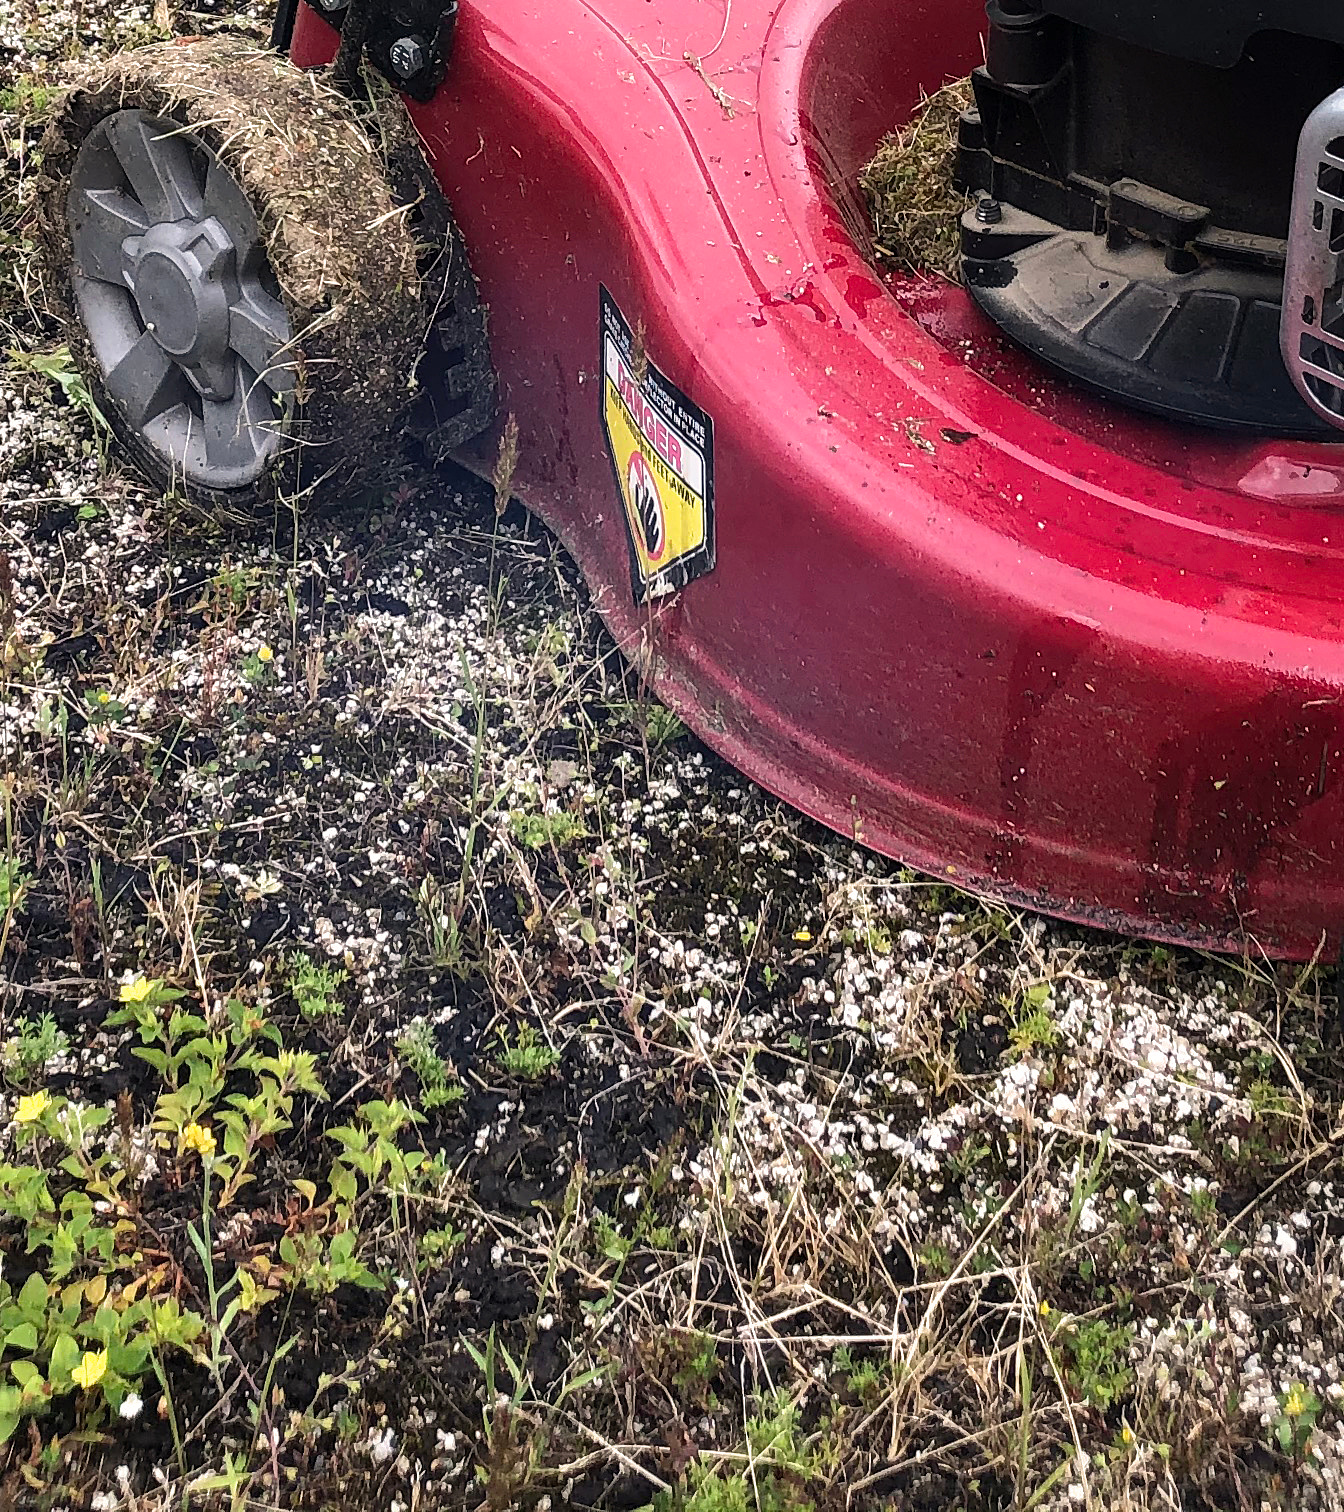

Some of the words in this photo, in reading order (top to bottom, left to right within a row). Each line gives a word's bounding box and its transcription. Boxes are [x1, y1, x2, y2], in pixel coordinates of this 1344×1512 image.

[618, 359, 682, 475] DANGER
[648, 374, 676, 409] WITHOUT
[678, 407, 706, 437] ENTIRE
[673, 413, 681, 428] IN
[681, 421, 705, 448] PLACE
[652, 454, 669, 484] FEET
[669, 475, 696, 509] AWAY
